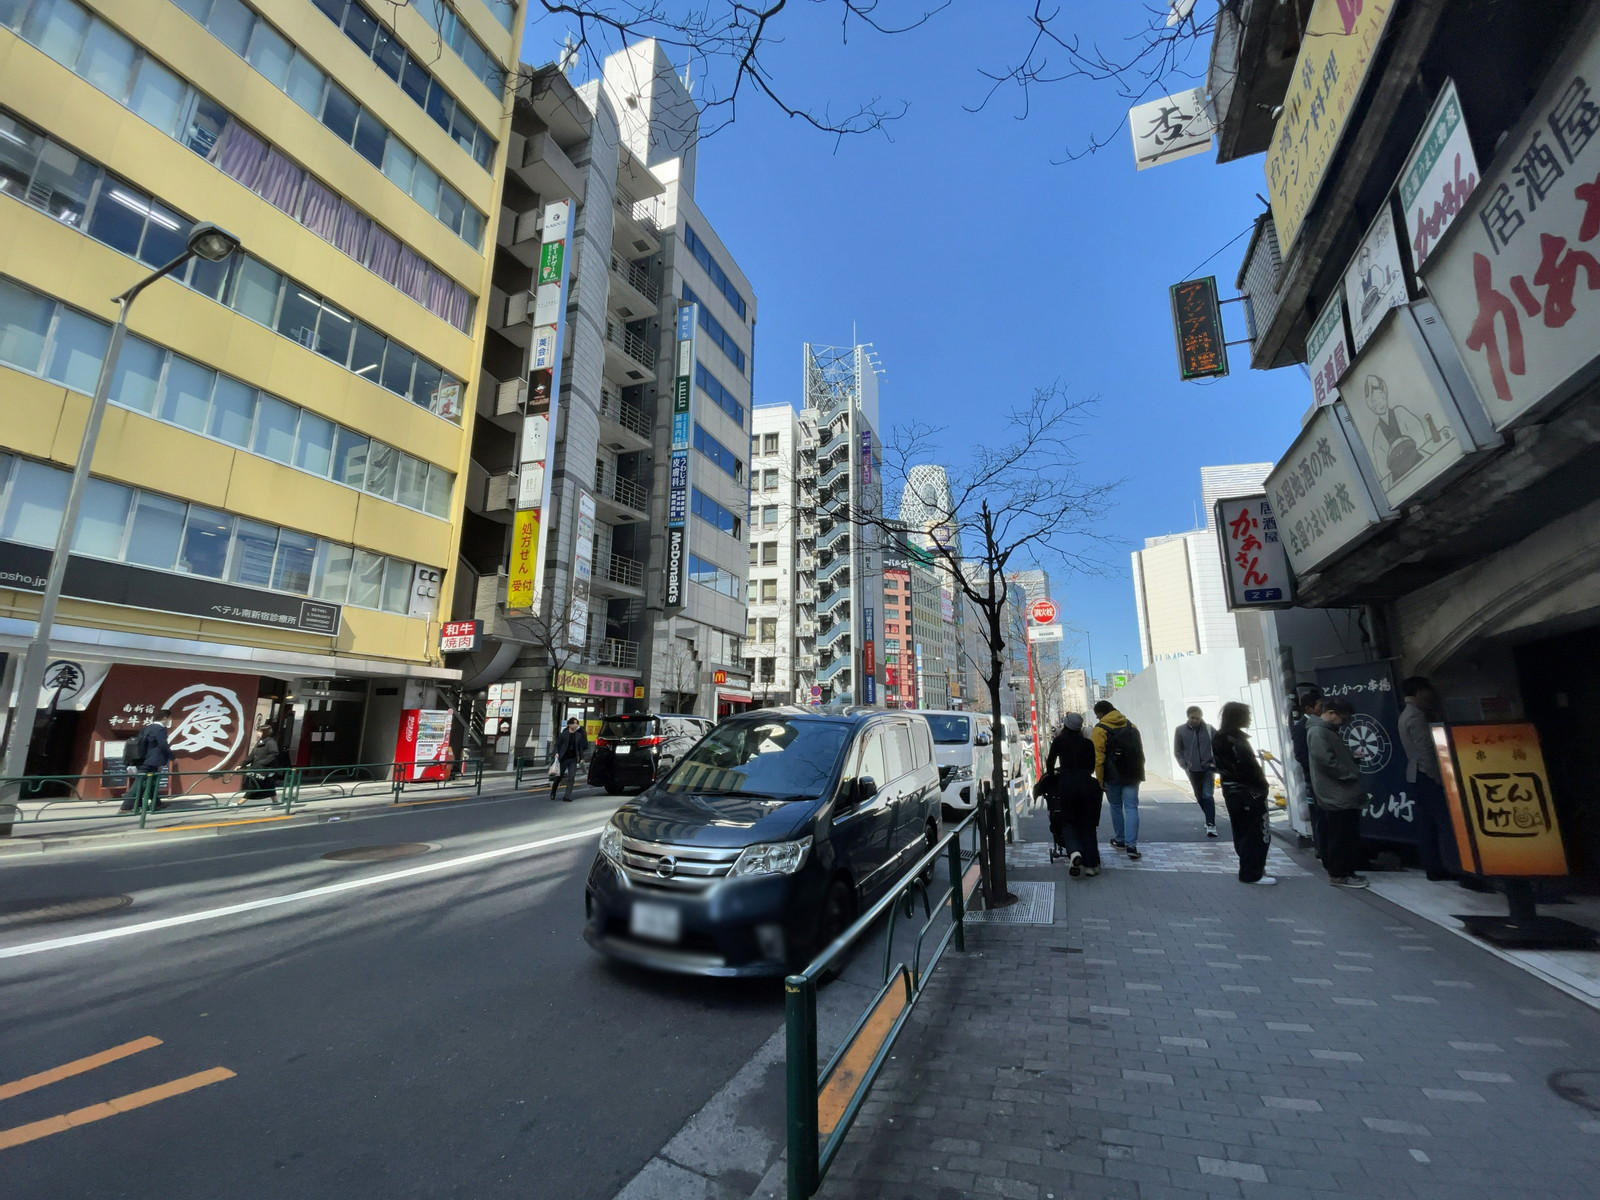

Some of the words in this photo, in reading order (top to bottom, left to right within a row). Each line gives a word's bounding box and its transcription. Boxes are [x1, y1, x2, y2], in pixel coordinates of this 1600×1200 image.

[1279, 48, 1341, 212] アジア料理
[1282, 221, 1296, 248] TEL
[1294, 118, 1337, 224] 3370-5579
[1479, 76, 1600, 255] 居酒屋
[1314, 340, 1349, 407] 居酒屋
[1274, 437, 1338, 519] 全国地酒の旅
[1260, 501, 1280, 544] 居酒屋
[518, 522, 533, 575] 処方せん
[667, 531, 682, 604] McDonald's
[1228, 508, 1269, 587] かあさん
[511, 579, 533, 593] 受付
[210, 604, 297, 625] ベテル南新宿診療所
[445, 622, 474, 635] 和牛
[1033, 607, 1054, 617] 消火栓
[444, 636, 472, 649] 焼肉
[122, 703, 156, 714] 南新宿
[167, 694, 232, 753] 慶
[1471, 733, 1523, 745] とんかつ
[1484, 783, 1533, 804] とん
[1487, 807, 1513, 829] 竹
